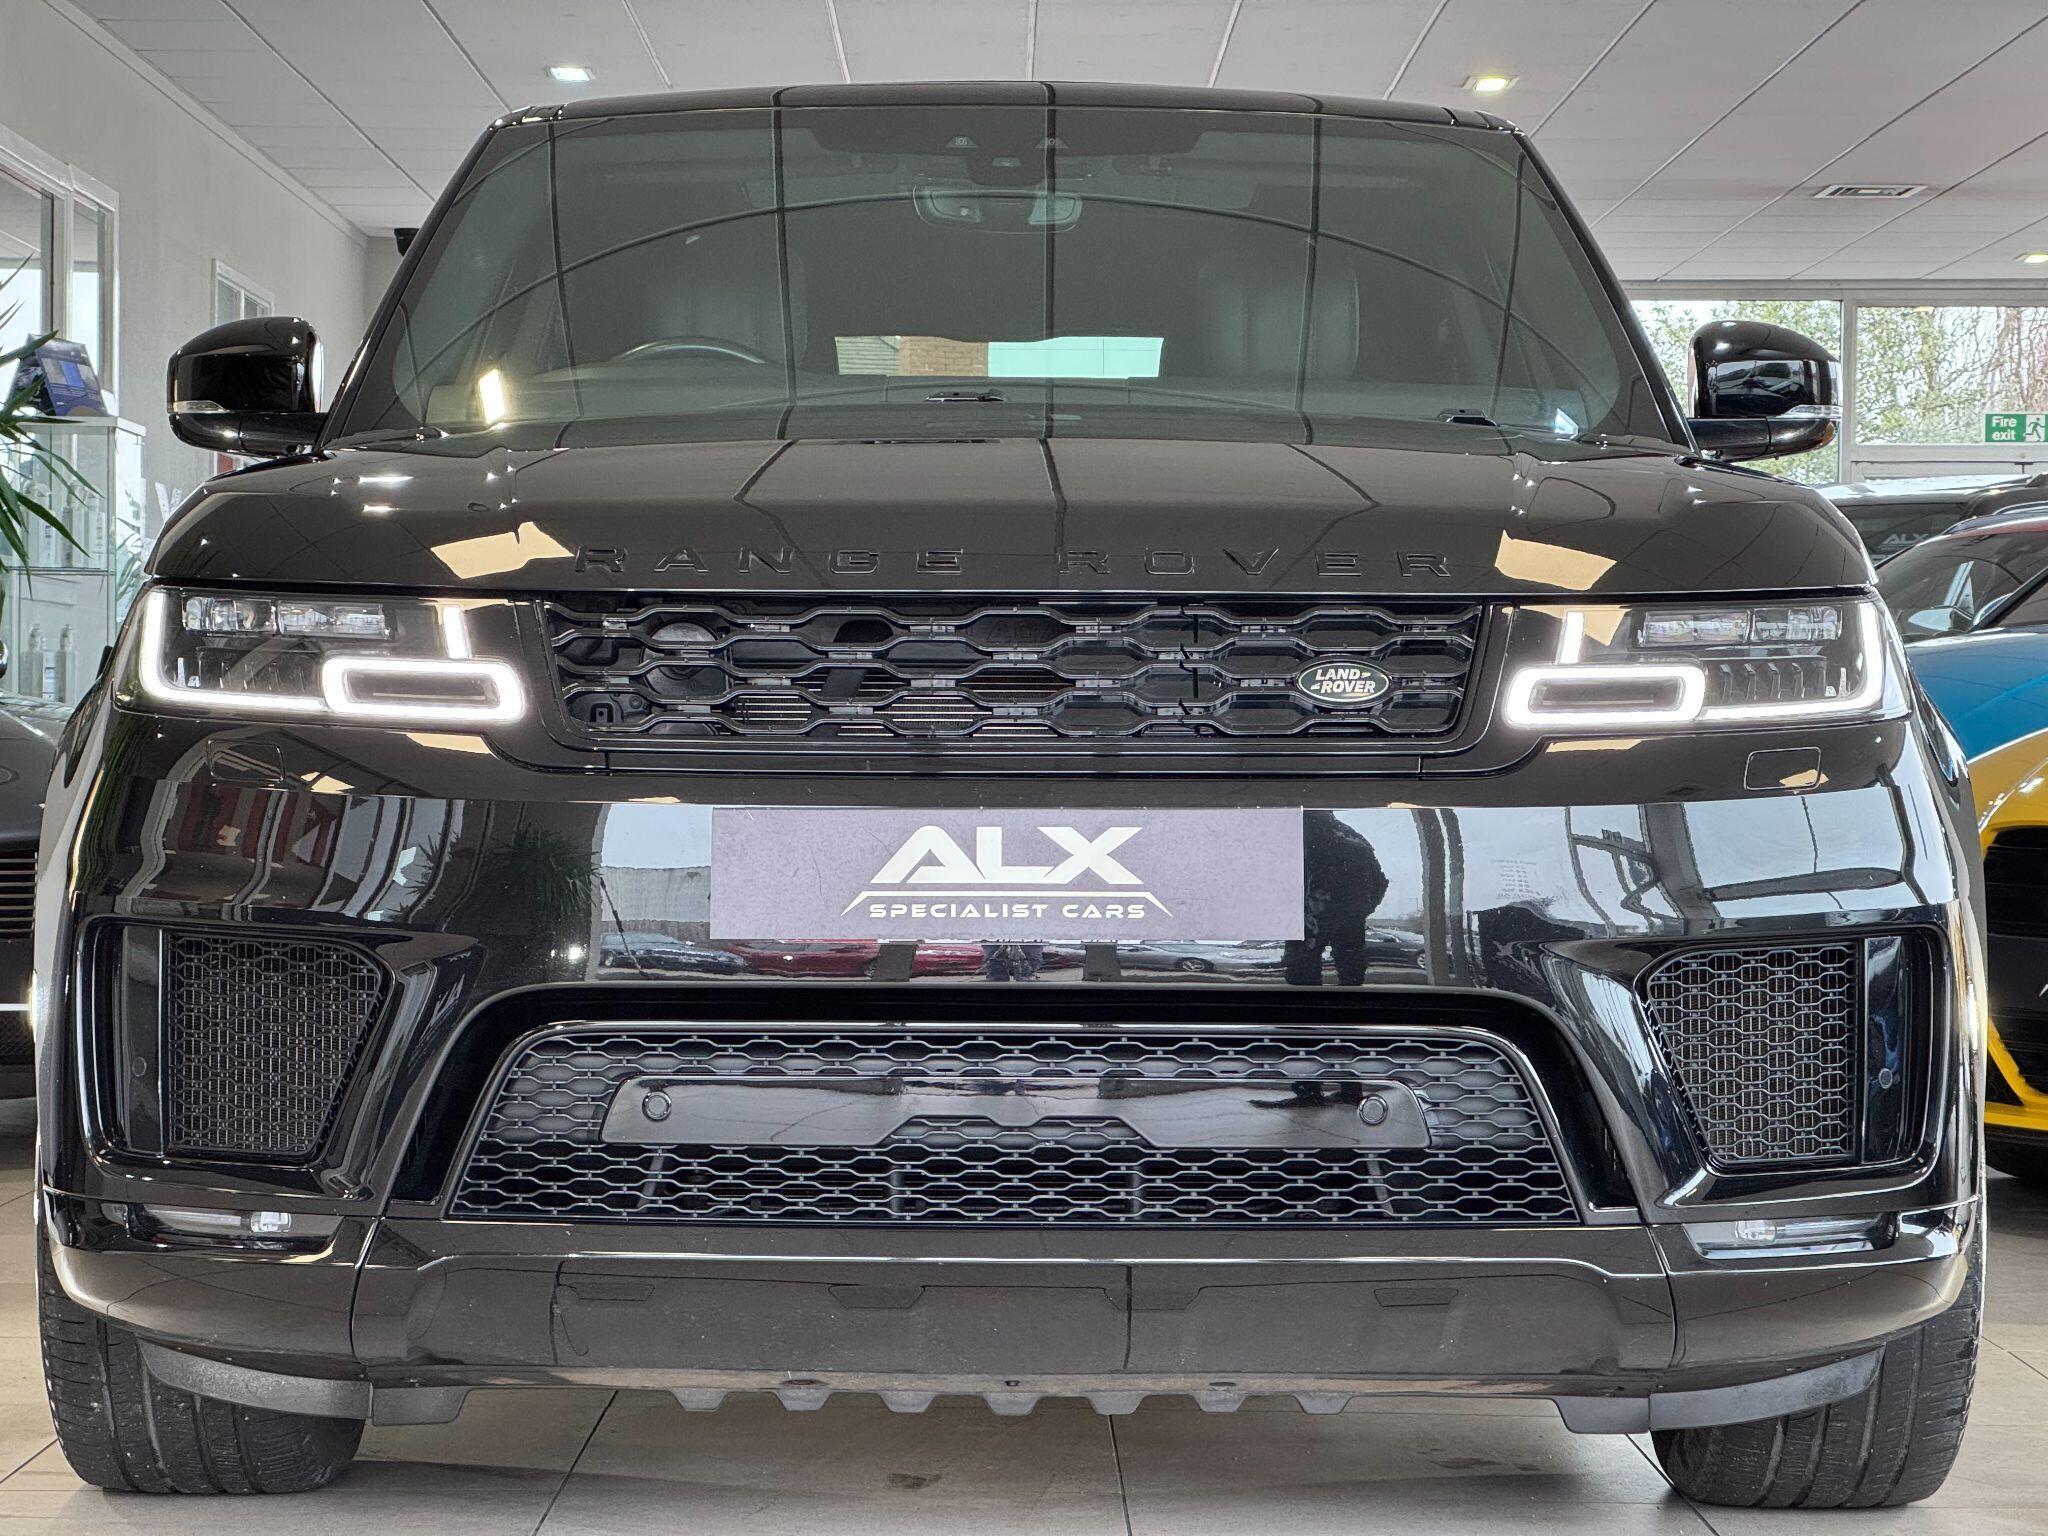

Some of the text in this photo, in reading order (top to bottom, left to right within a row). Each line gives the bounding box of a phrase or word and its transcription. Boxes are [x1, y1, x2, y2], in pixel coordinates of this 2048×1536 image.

[1992, 416, 2017, 428] Fire
[1992, 430, 2016, 441] exit
[574, 546, 1451, 578] RANGE ROVER
[1315, 668, 1360, 681] LAND
[1320, 680, 1376, 694] ROVER
[870, 825, 1143, 885] ALX
[869, 903, 1145, 919] SPECIALIST CARS
